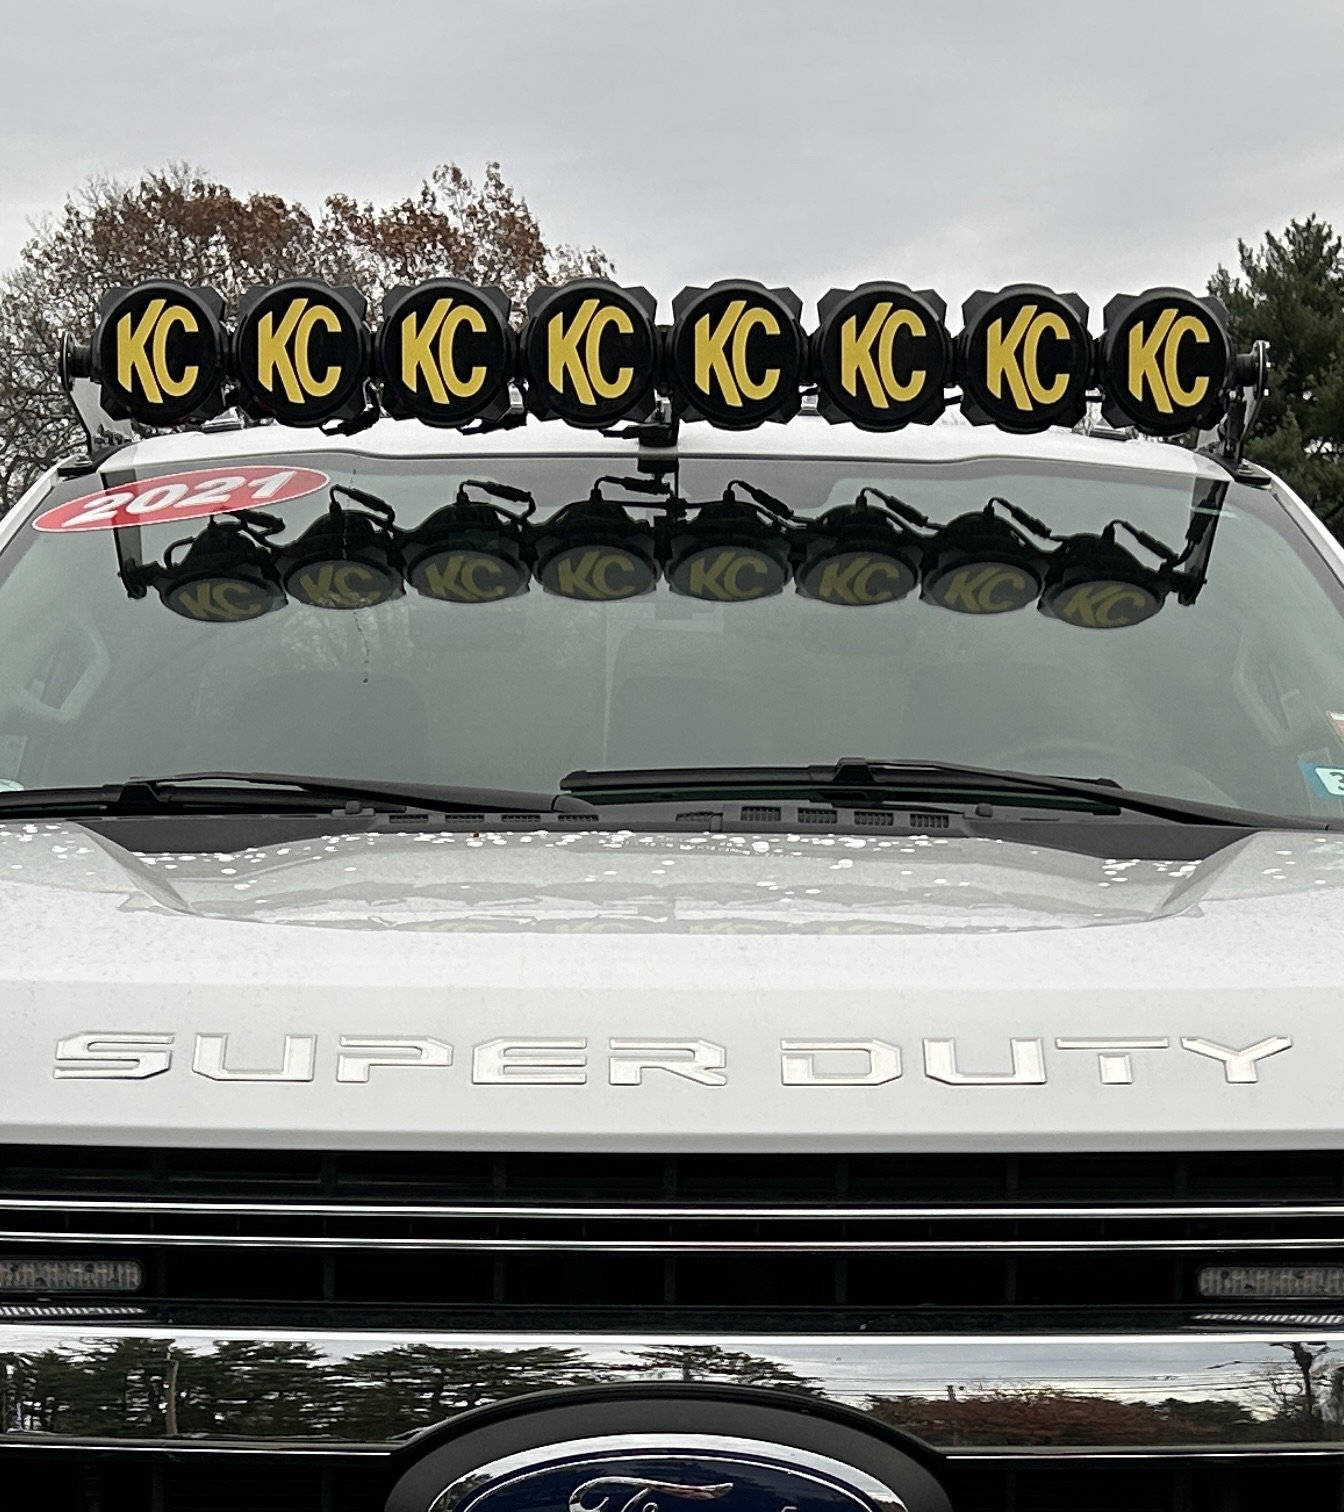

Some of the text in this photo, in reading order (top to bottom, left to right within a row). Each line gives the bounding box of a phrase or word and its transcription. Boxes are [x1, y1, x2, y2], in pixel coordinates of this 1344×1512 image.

[117, 297, 200, 404] KC
[257, 297, 342, 404] KC
[401, 297, 487, 405] KC
[548, 298, 634, 405] KC
[694, 300, 781, 407] KC
[840, 302, 927, 409] KC
[986, 304, 1071, 411] KC
[1127, 308, 1210, 414] KC
[61, 470, 298, 528] 2021
[176, 581, 262, 621] KC
[299, 560, 382, 602] KC
[425, 555, 503, 598] KC
[558, 551, 635, 598] KC
[689, 551, 768, 599] KC
[818, 557, 902, 602] KC
[944, 562, 1029, 610] KC
[1064, 584, 1144, 625] KC
[51, 1030, 1295, 1086] SUPER DUTY
